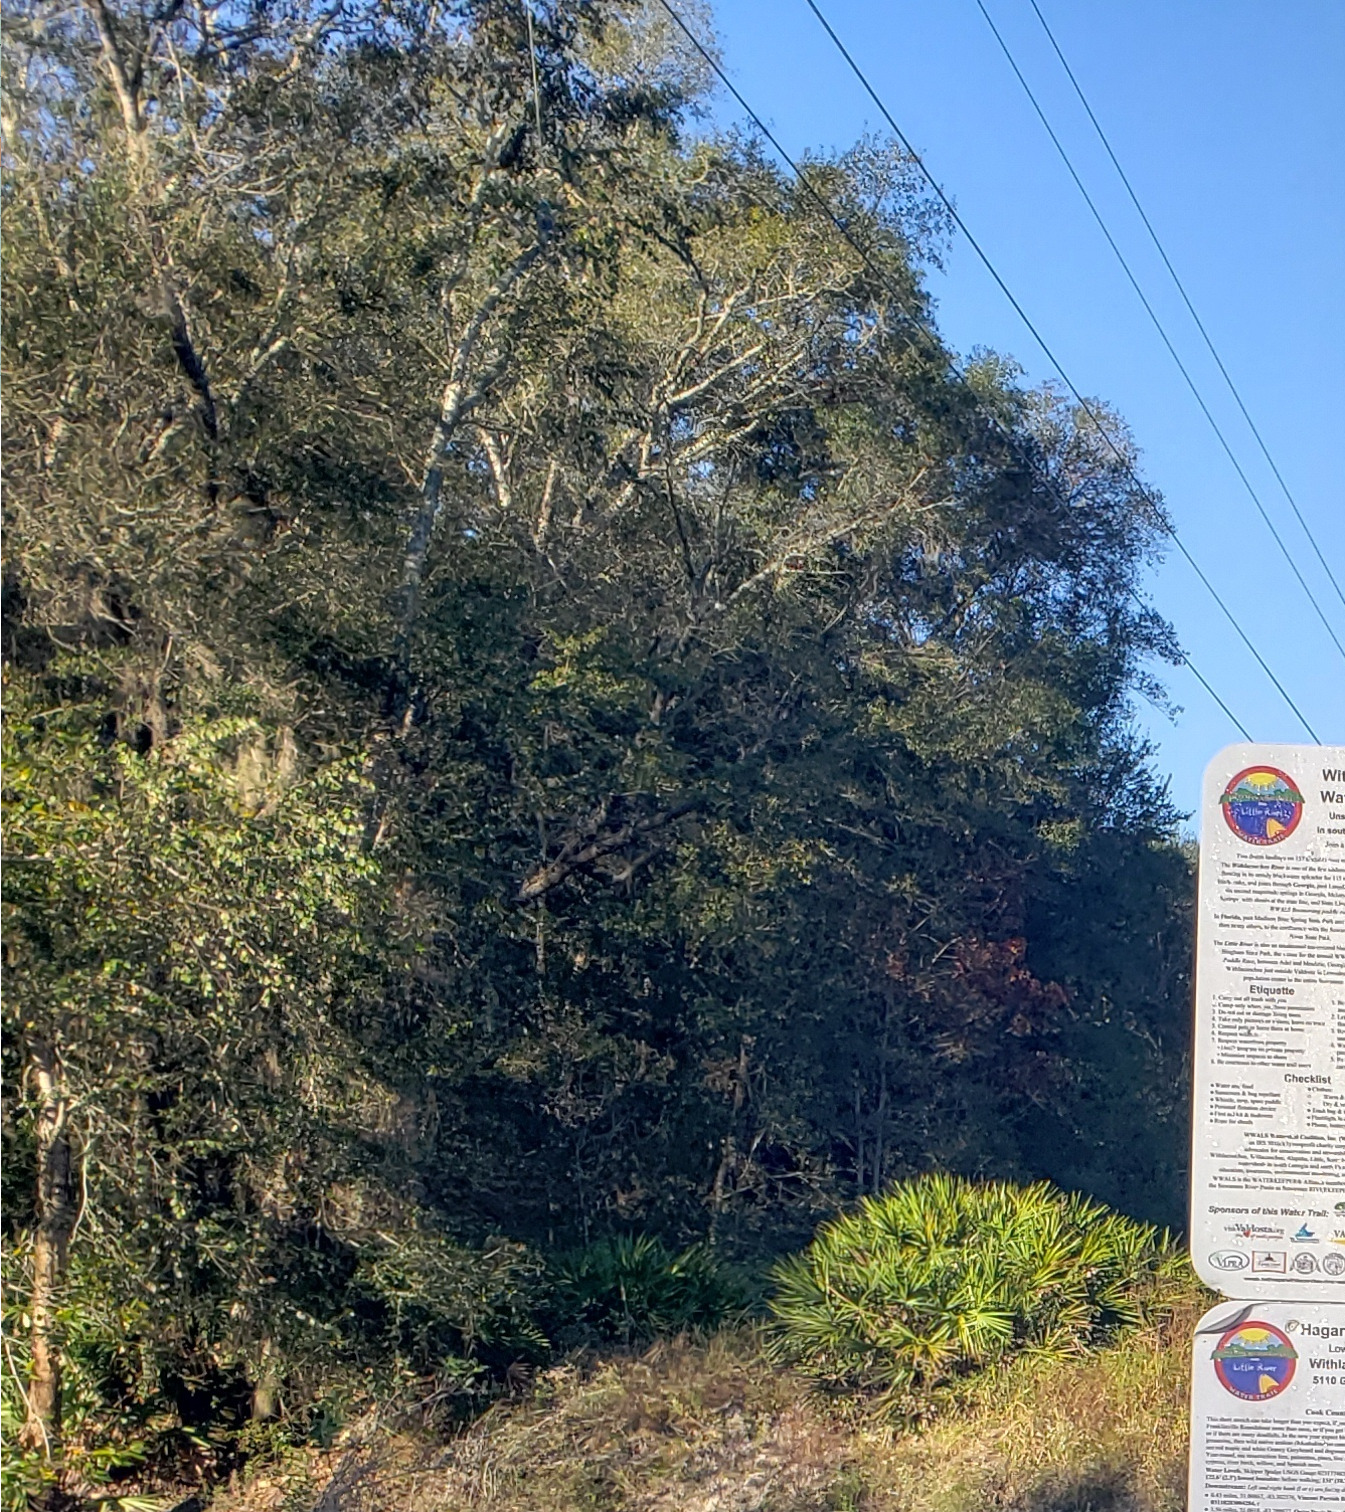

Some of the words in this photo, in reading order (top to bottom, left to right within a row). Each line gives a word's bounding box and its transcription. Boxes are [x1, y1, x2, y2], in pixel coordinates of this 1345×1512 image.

[1249, 984, 1295, 996] Etiquette
[1284, 1074, 1332, 1085] Checklist
[1208, 1206, 1249, 1214] Sponsors
[1280, 1208, 1305, 1216] Water
[1307, 1209, 1329, 1217] Trail:
[1233, 1363, 1258, 1371] Little
[1312, 1376, 1336, 1385] 5110
